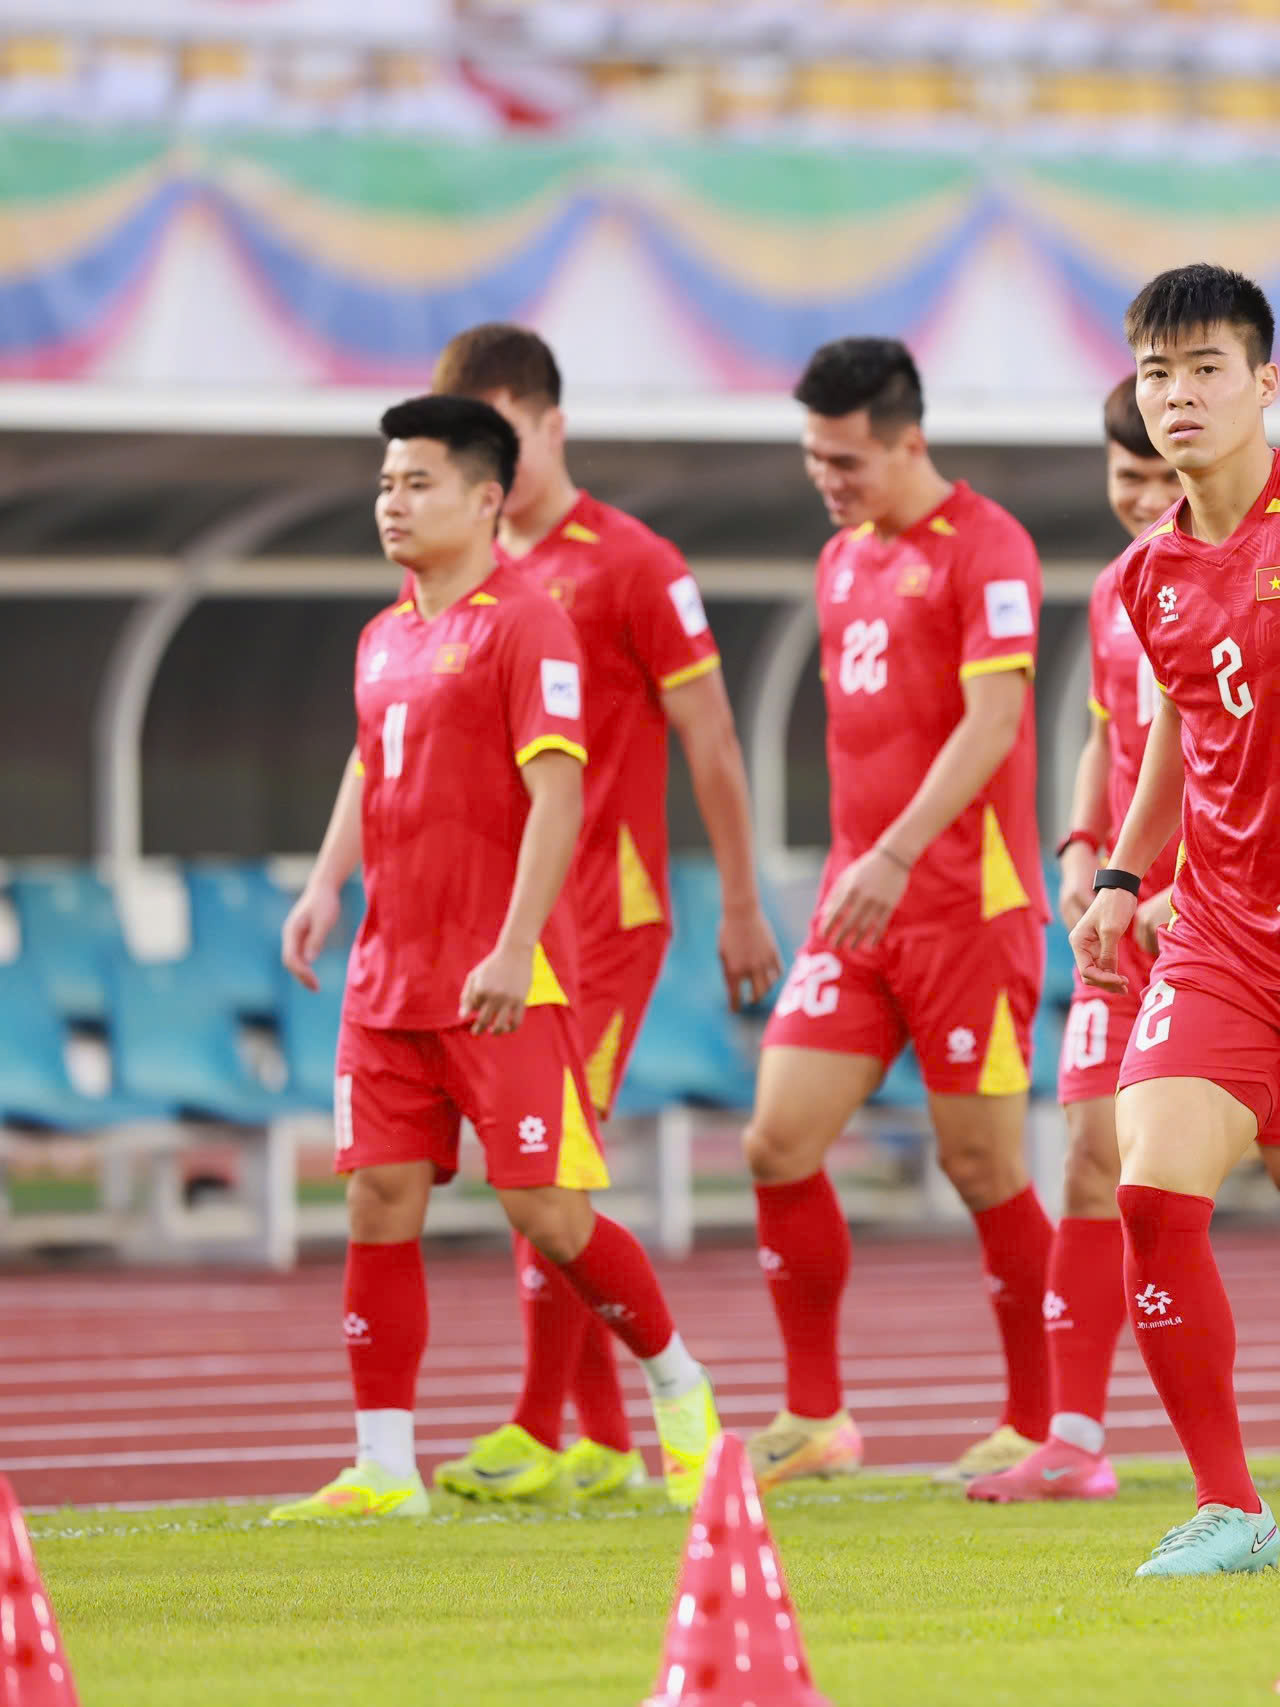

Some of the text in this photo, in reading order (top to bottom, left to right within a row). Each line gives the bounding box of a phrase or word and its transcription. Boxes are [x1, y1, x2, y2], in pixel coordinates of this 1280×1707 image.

[840, 618, 889, 696] 22
[1136, 652, 1161, 728] 1
[1211, 636, 1254, 719] 2
[383, 702, 408, 780] 11
[1135, 979, 1176, 1052] 2
